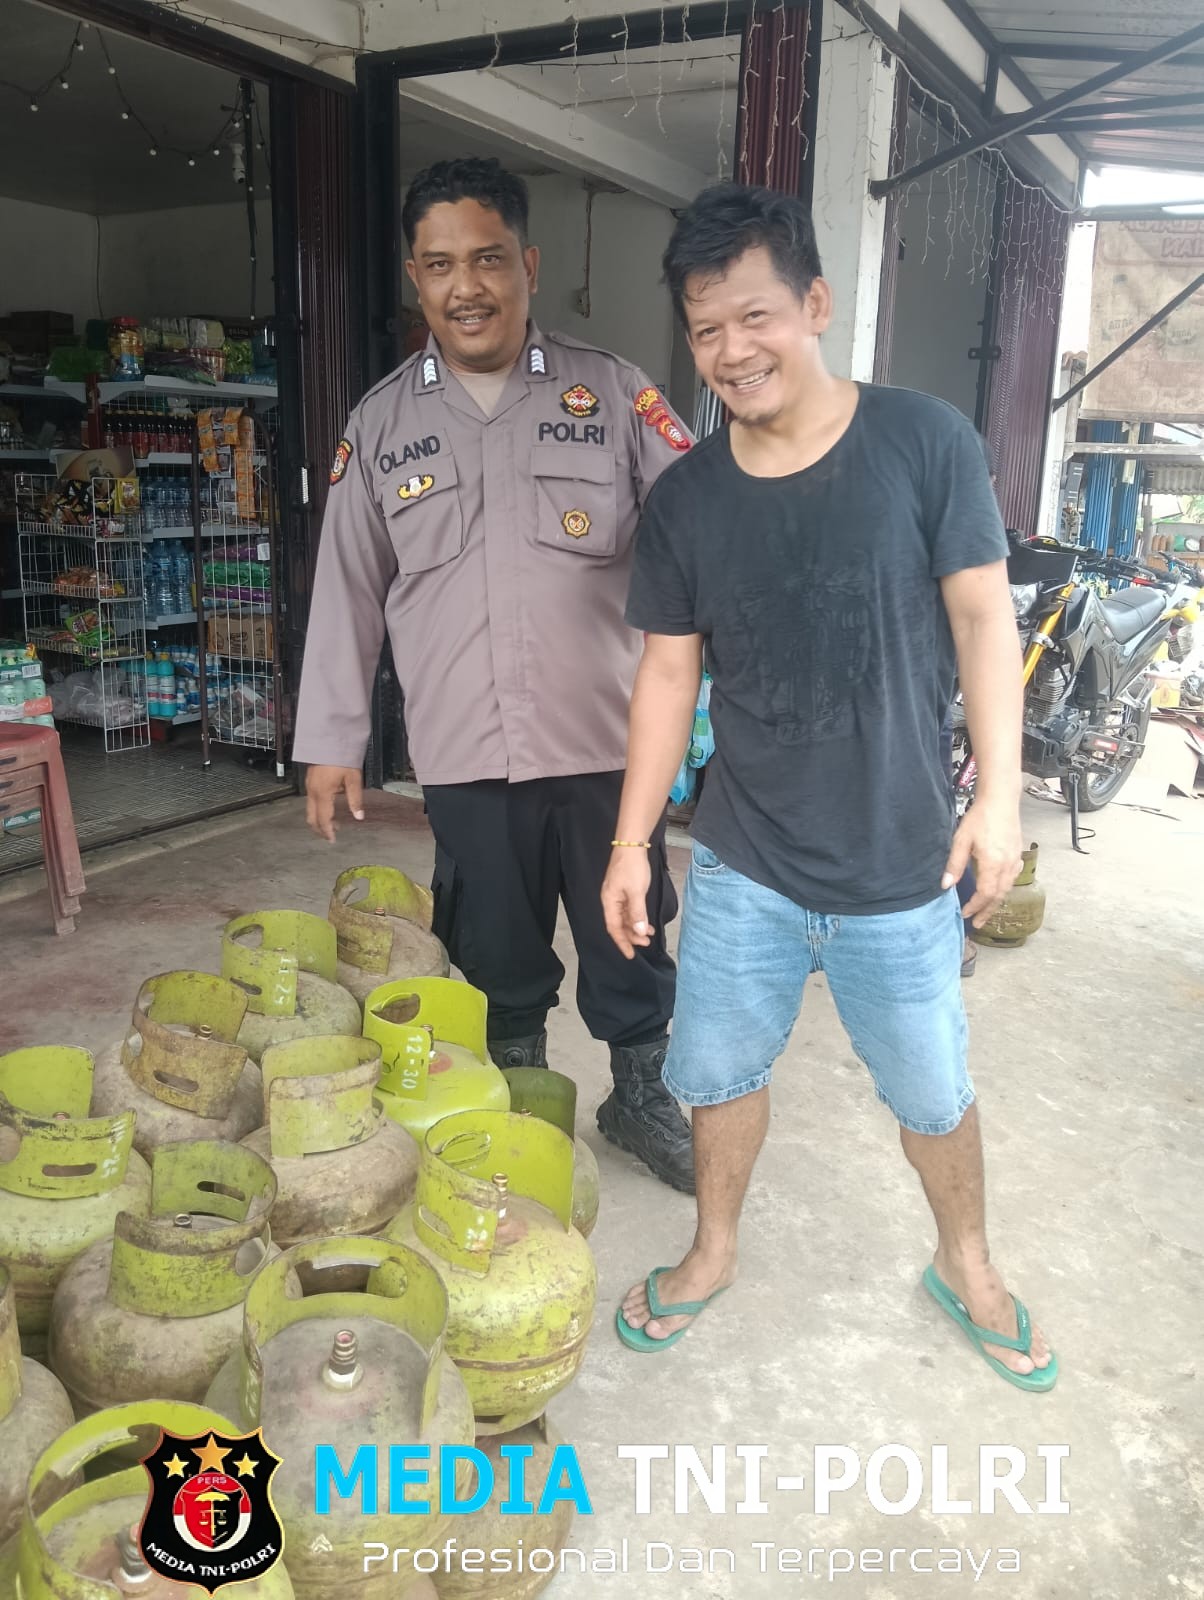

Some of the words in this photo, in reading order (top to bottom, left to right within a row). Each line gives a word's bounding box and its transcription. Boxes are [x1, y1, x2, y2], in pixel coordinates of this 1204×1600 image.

[537, 422, 606, 446] POLRI
[378, 435, 442, 475] OLAND
[402, 1035, 423, 1089] 12-30
